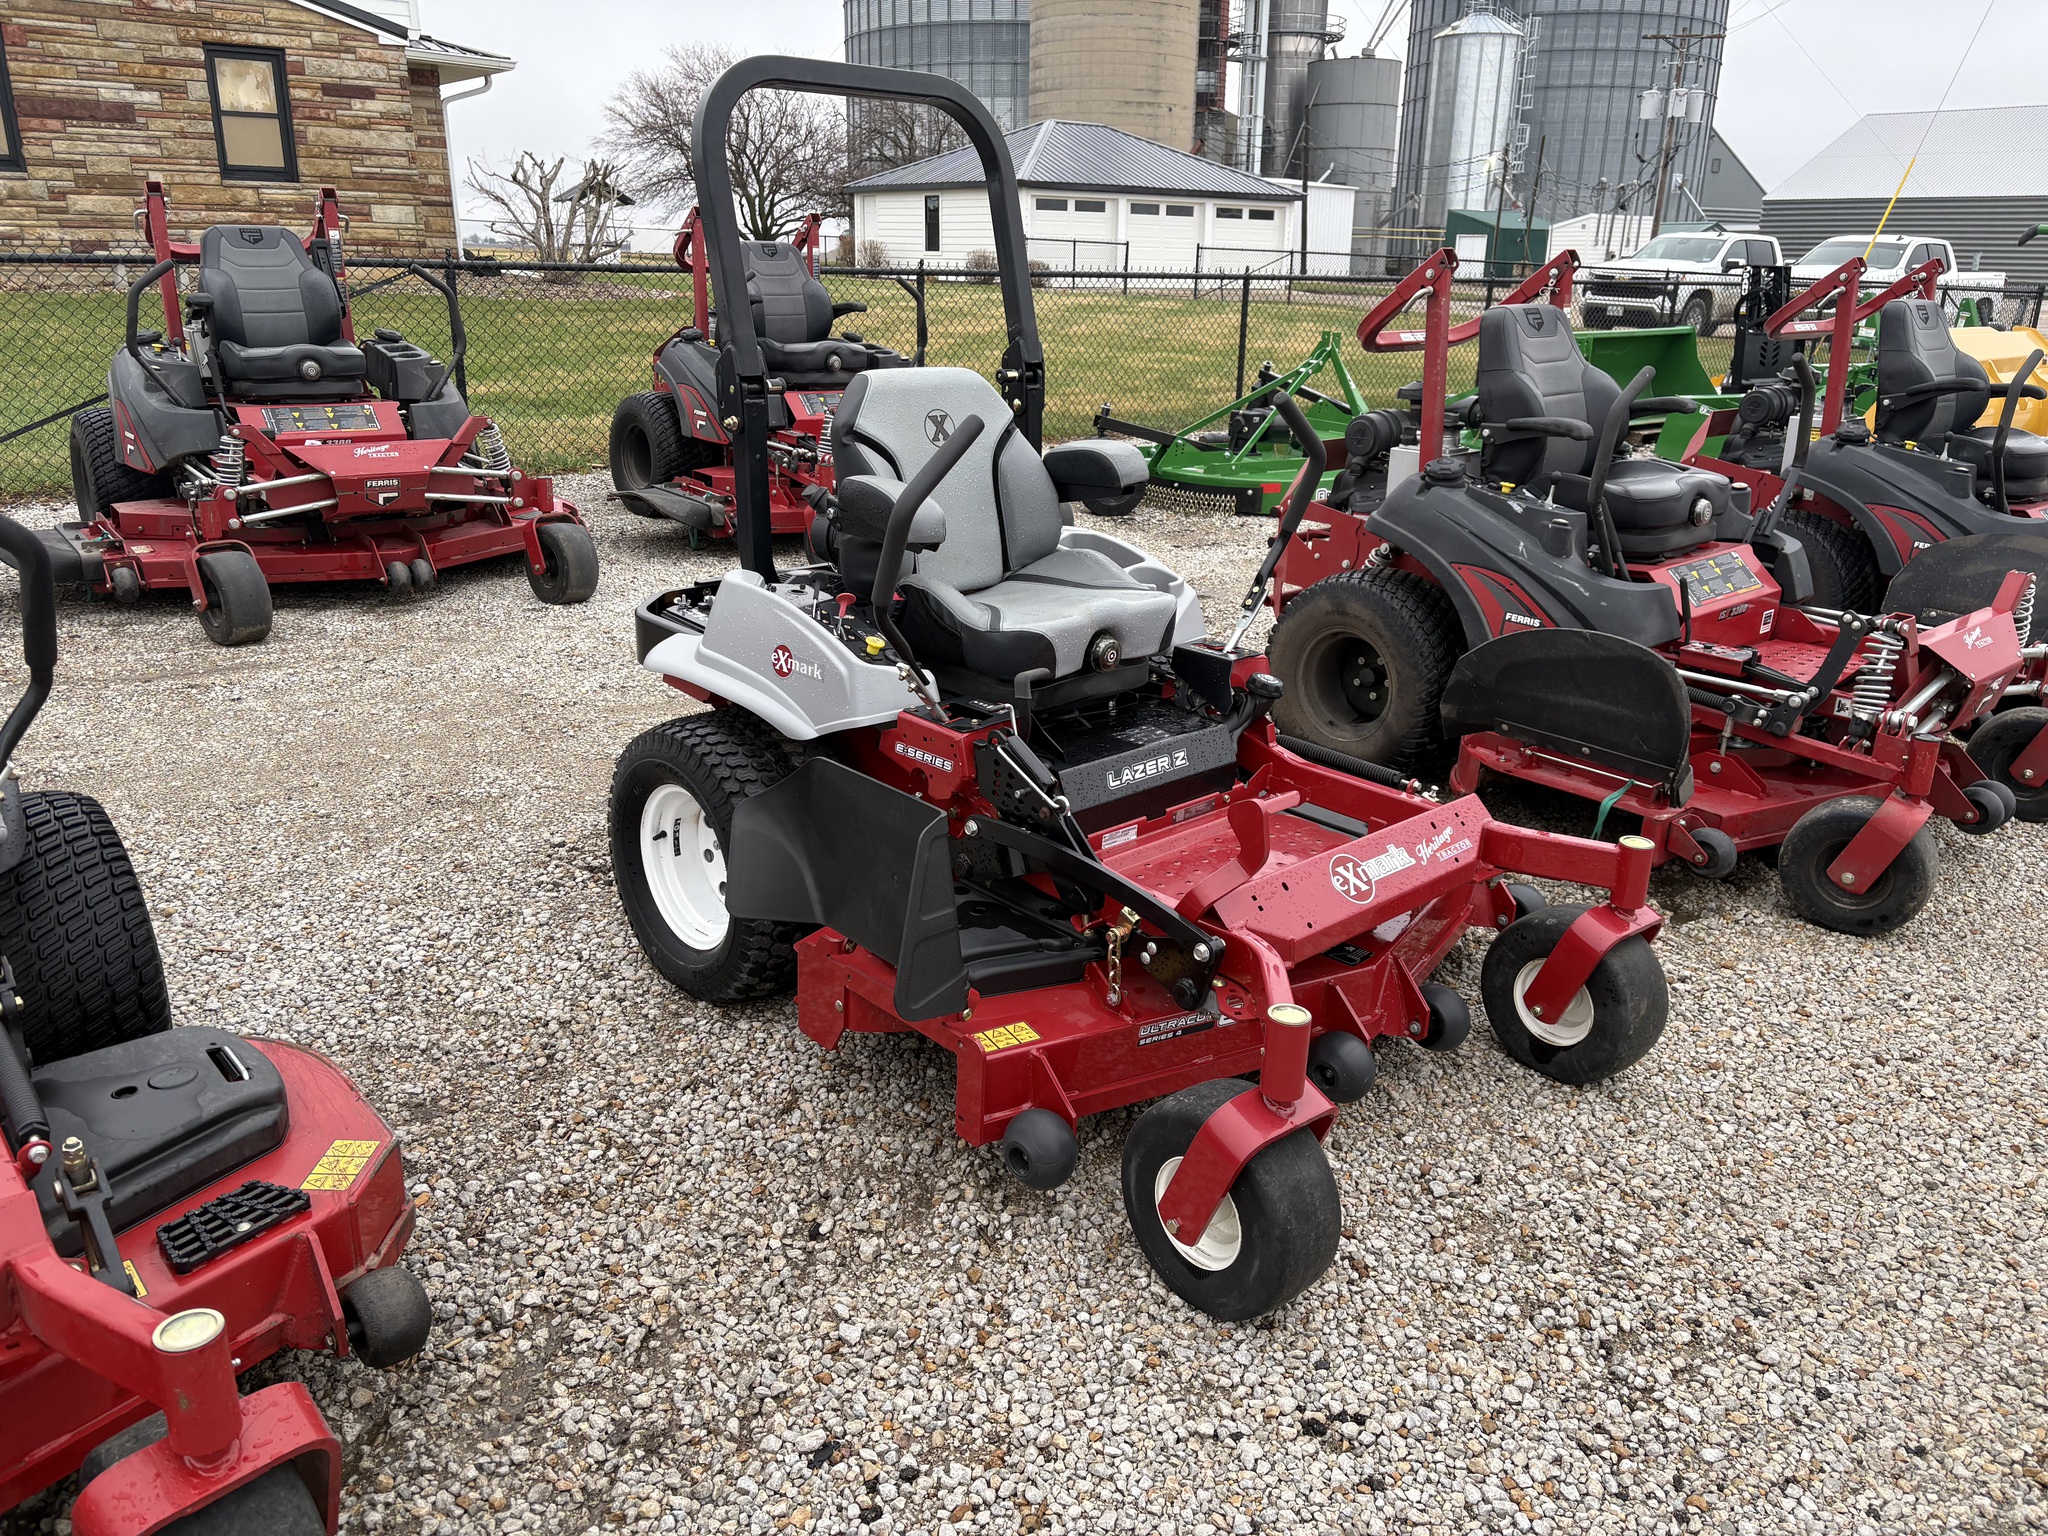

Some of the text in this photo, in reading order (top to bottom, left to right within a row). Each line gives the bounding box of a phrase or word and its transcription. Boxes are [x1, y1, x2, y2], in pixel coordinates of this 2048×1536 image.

[928, 414, 950, 442] X
[354, 444, 391, 458] Heritage
[366, 479, 399, 487] FERRIS
[1913, 541, 1931, 549] FER
[1505, 612, 1540, 628] FERRIS
[771, 649, 822, 680] eXmark
[895, 742, 953, 771] E-SERIES
[1108, 750, 1188, 788] LAZER Z
[1416, 826, 1453, 866] Heritage
[1436, 838, 1473, 861] TRACTOR
[1333, 845, 1415, 896] eXmark
[1138, 1032, 1174, 1046] SERIES
